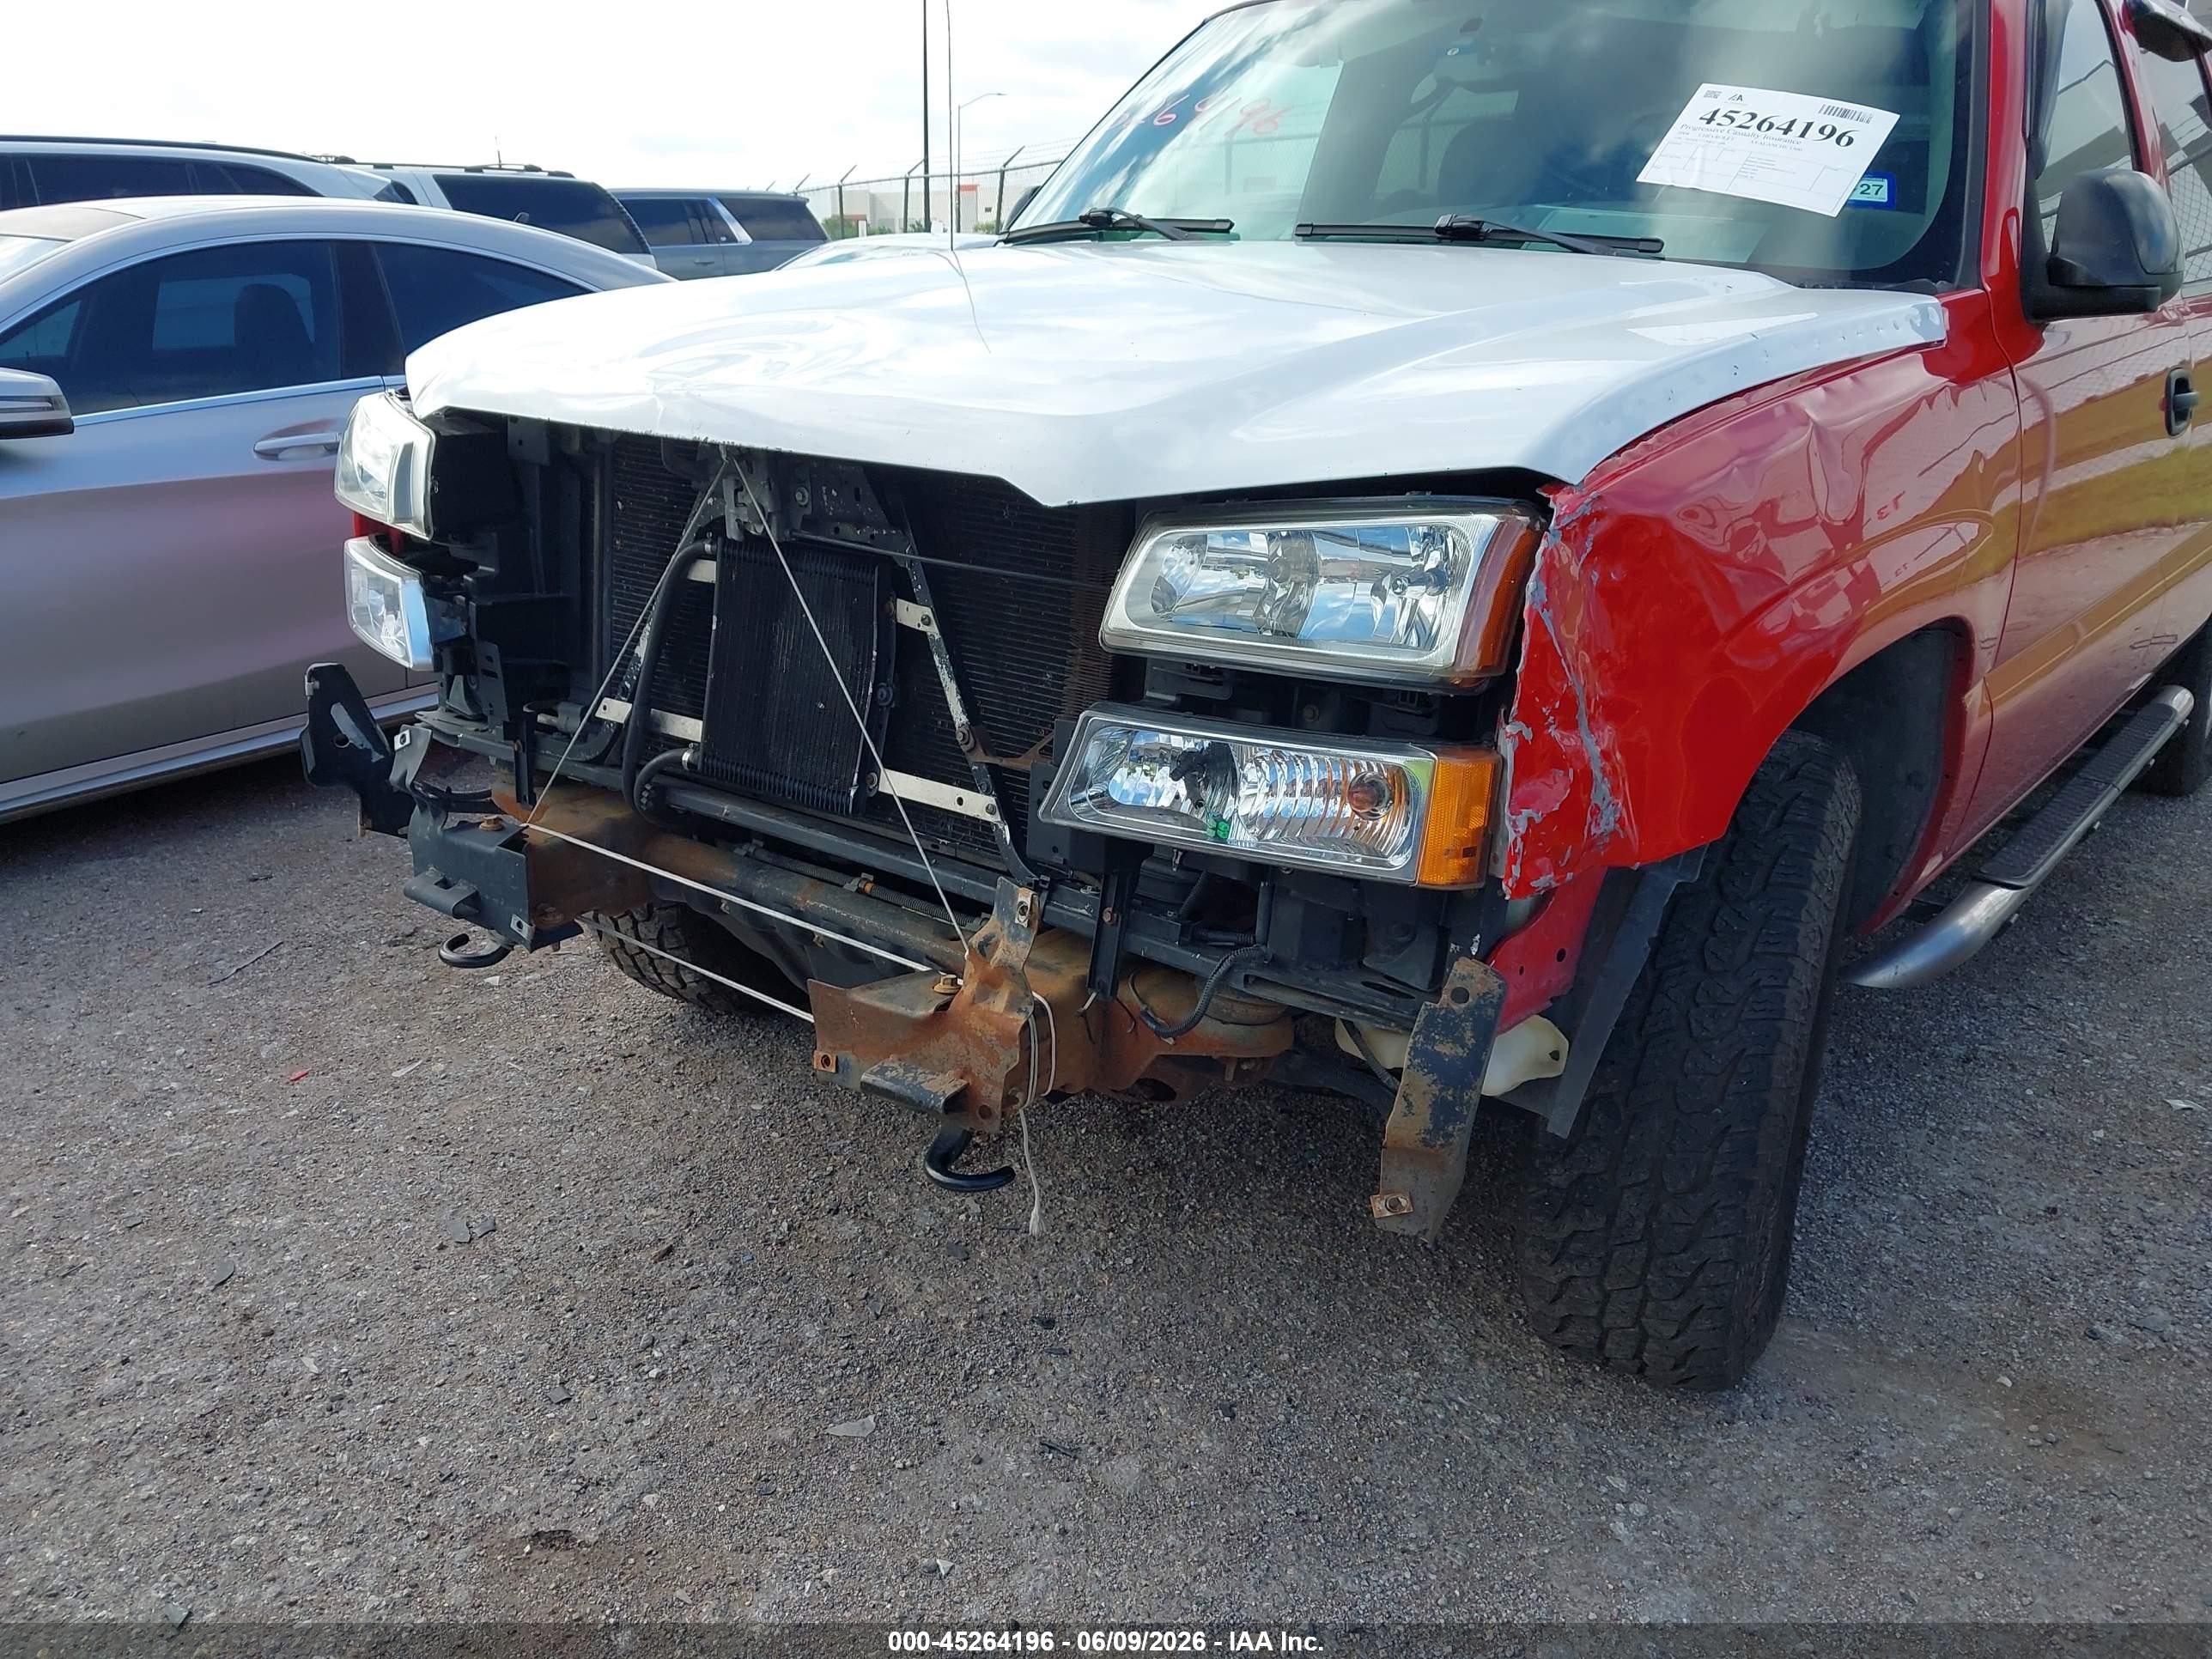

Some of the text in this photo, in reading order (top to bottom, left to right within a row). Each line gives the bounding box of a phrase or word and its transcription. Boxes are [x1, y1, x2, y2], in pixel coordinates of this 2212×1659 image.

[1680, 124, 1802, 145] Progressive Casualty Insurance
[1699, 107, 1861, 148] 45264196
